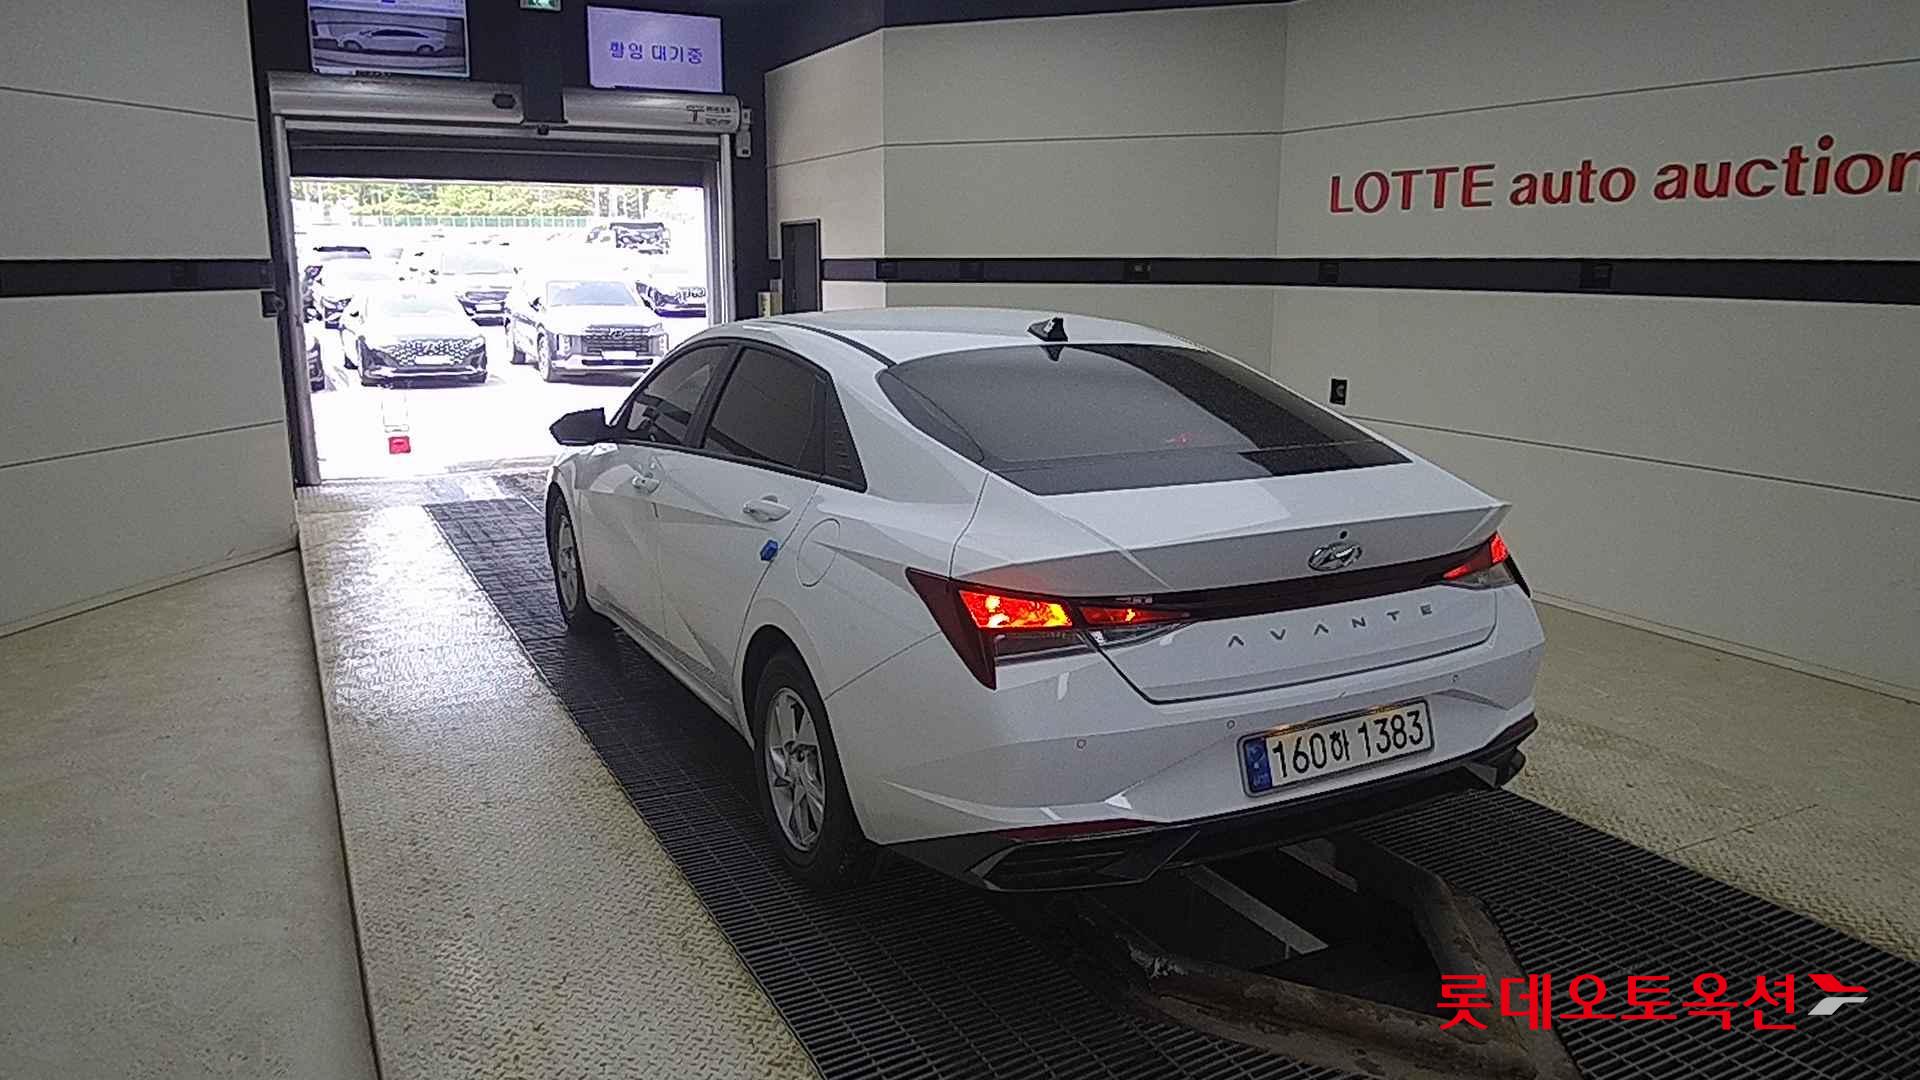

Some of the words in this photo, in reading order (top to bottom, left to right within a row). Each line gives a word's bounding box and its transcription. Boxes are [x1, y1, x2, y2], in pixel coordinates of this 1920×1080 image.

[651, 45, 703, 65] 대기중
[1330, 163, 1496, 213] LOTTE
[1510, 160, 1637, 206] auto
[1228, 604, 1433, 648] AVANTE
[1272, 729, 1351, 778] 160하
[1357, 710, 1424, 758] 1383
